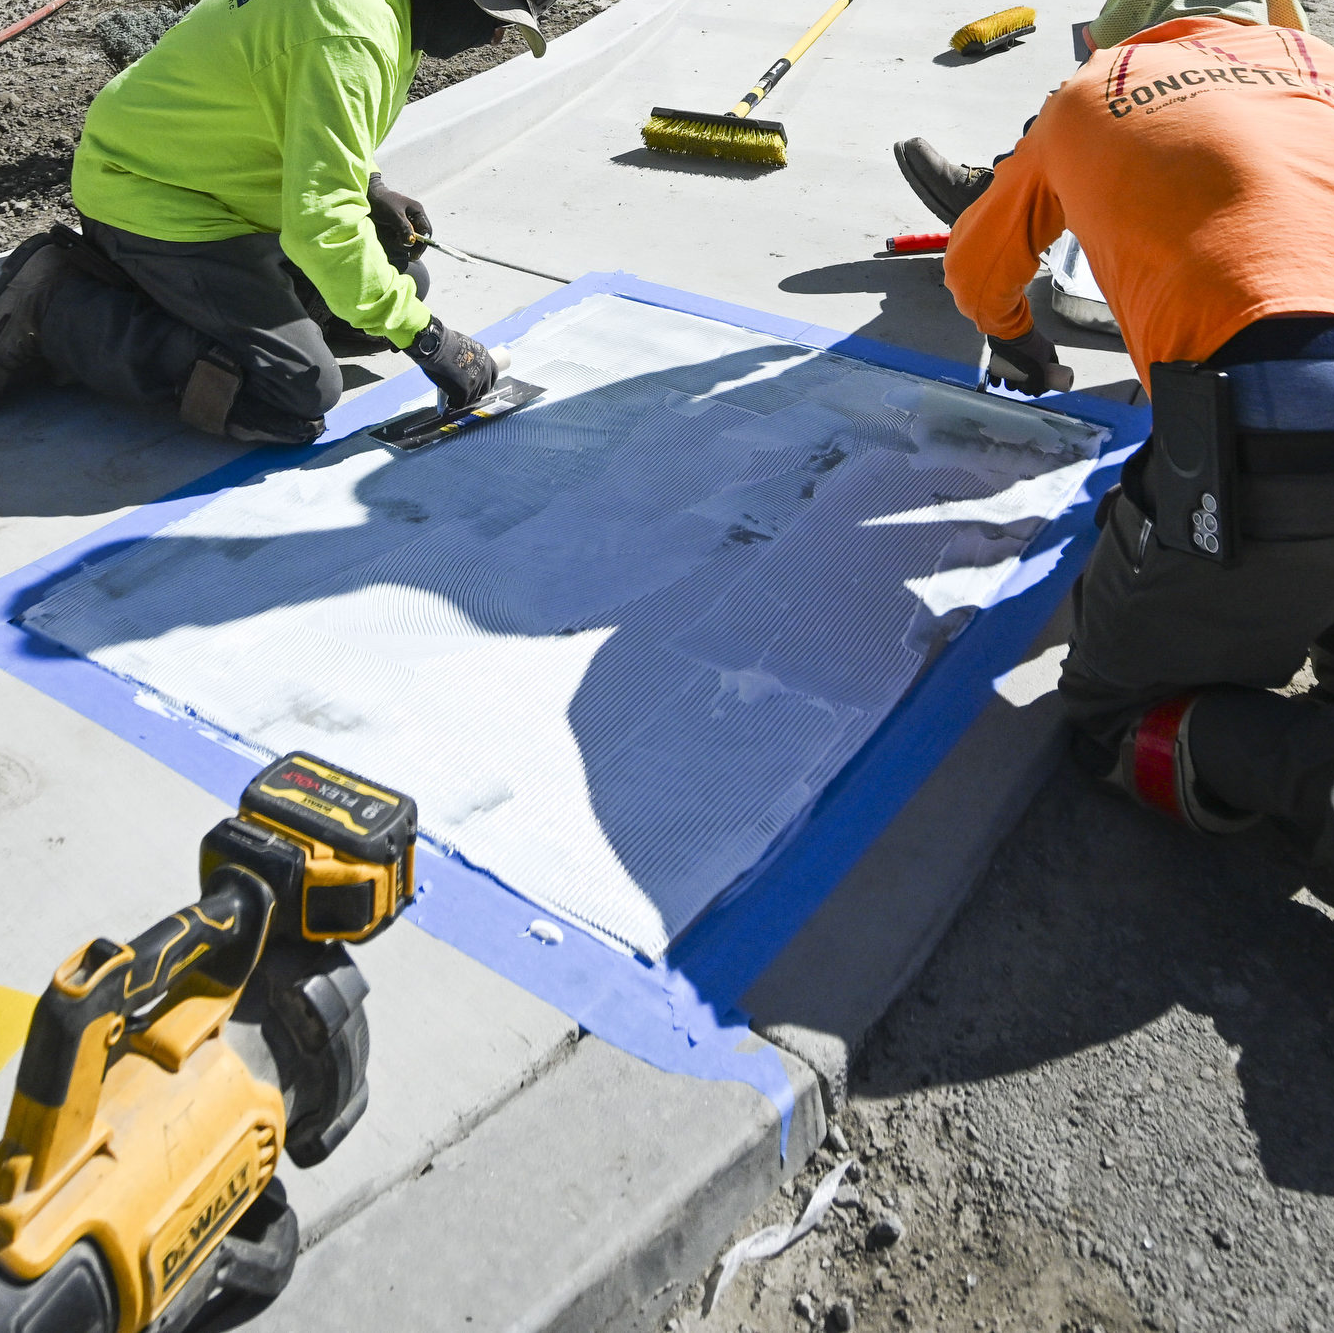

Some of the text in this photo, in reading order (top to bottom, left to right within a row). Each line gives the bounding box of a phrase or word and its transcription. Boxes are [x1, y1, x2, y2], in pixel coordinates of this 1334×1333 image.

[1108, 67, 1303, 118] CONCRETE
[1145, 93, 1188, 115] Quality
[282, 771, 359, 808] FLEXVOLT
